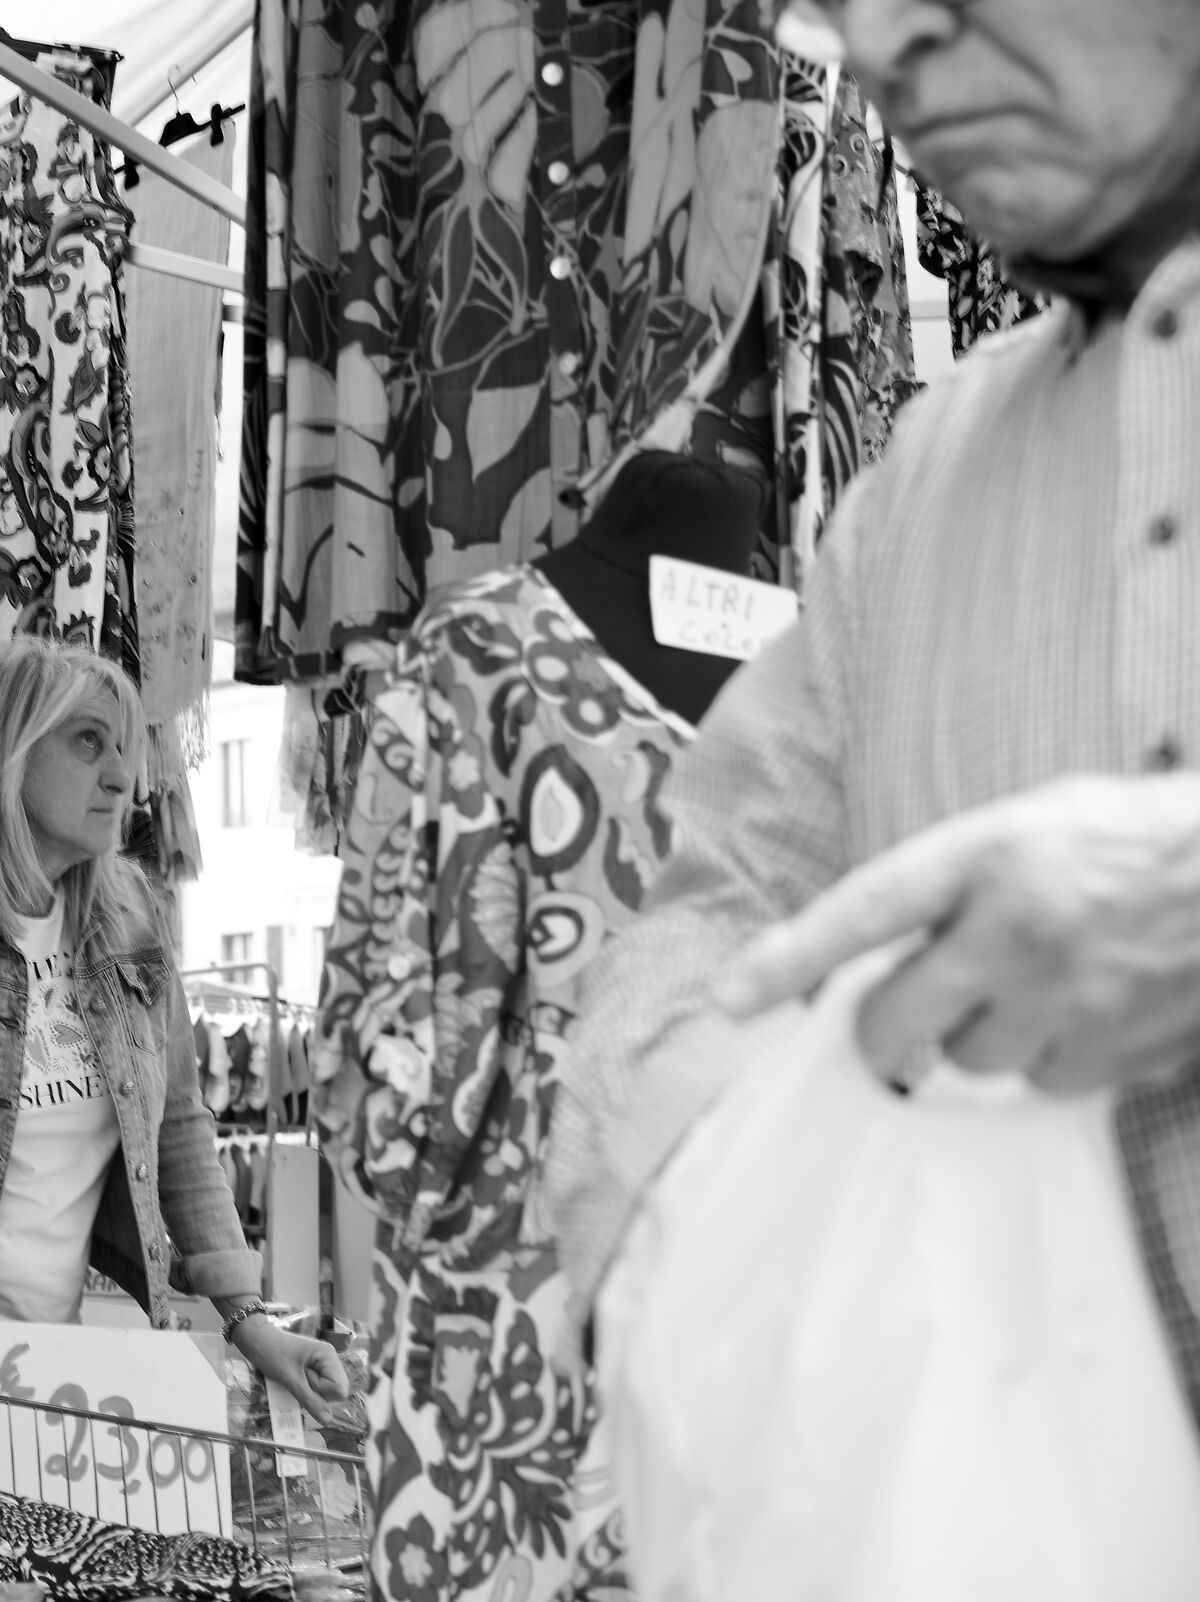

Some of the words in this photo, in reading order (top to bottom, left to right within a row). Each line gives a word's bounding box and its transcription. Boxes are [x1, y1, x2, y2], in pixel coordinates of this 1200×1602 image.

[659, 567, 755, 622] ALTRI
[18, 1073, 104, 1111] SHINE
[44, 1382, 214, 1496] 23,00
